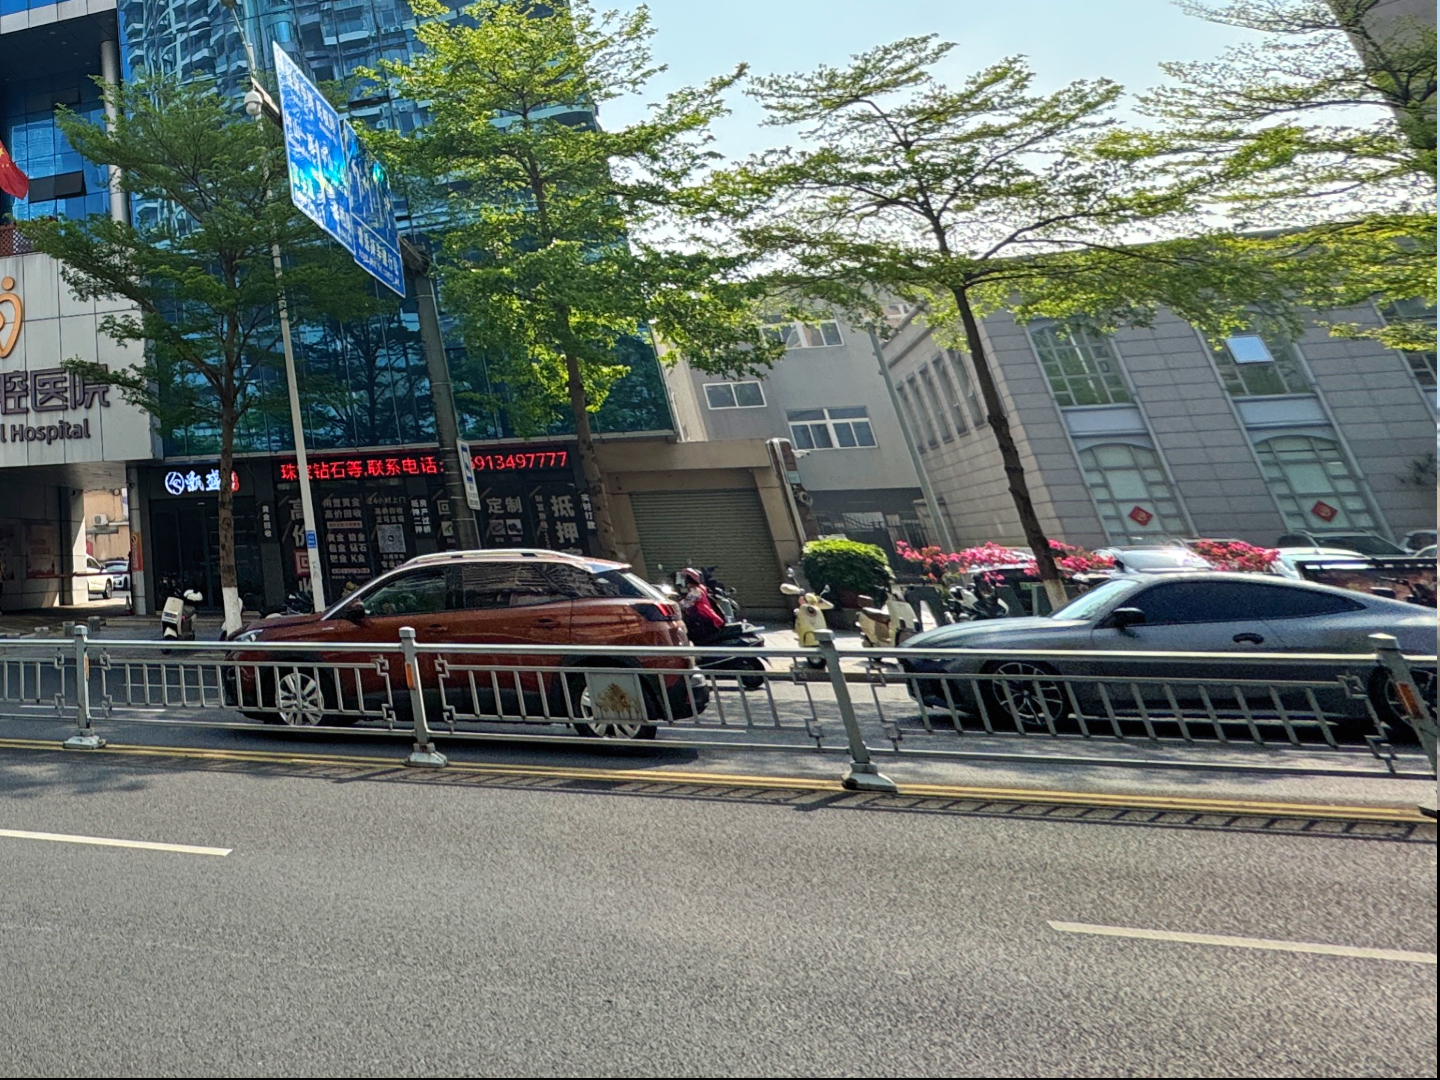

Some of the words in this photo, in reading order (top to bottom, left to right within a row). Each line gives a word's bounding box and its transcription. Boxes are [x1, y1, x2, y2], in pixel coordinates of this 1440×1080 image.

[10, 418, 91, 445] Hospital
[486, 496, 523, 514] 定制
[324, 509, 362, 519] 高价回收
[349, 543, 367, 552] 钻石
[351, 553, 366, 563] K金
